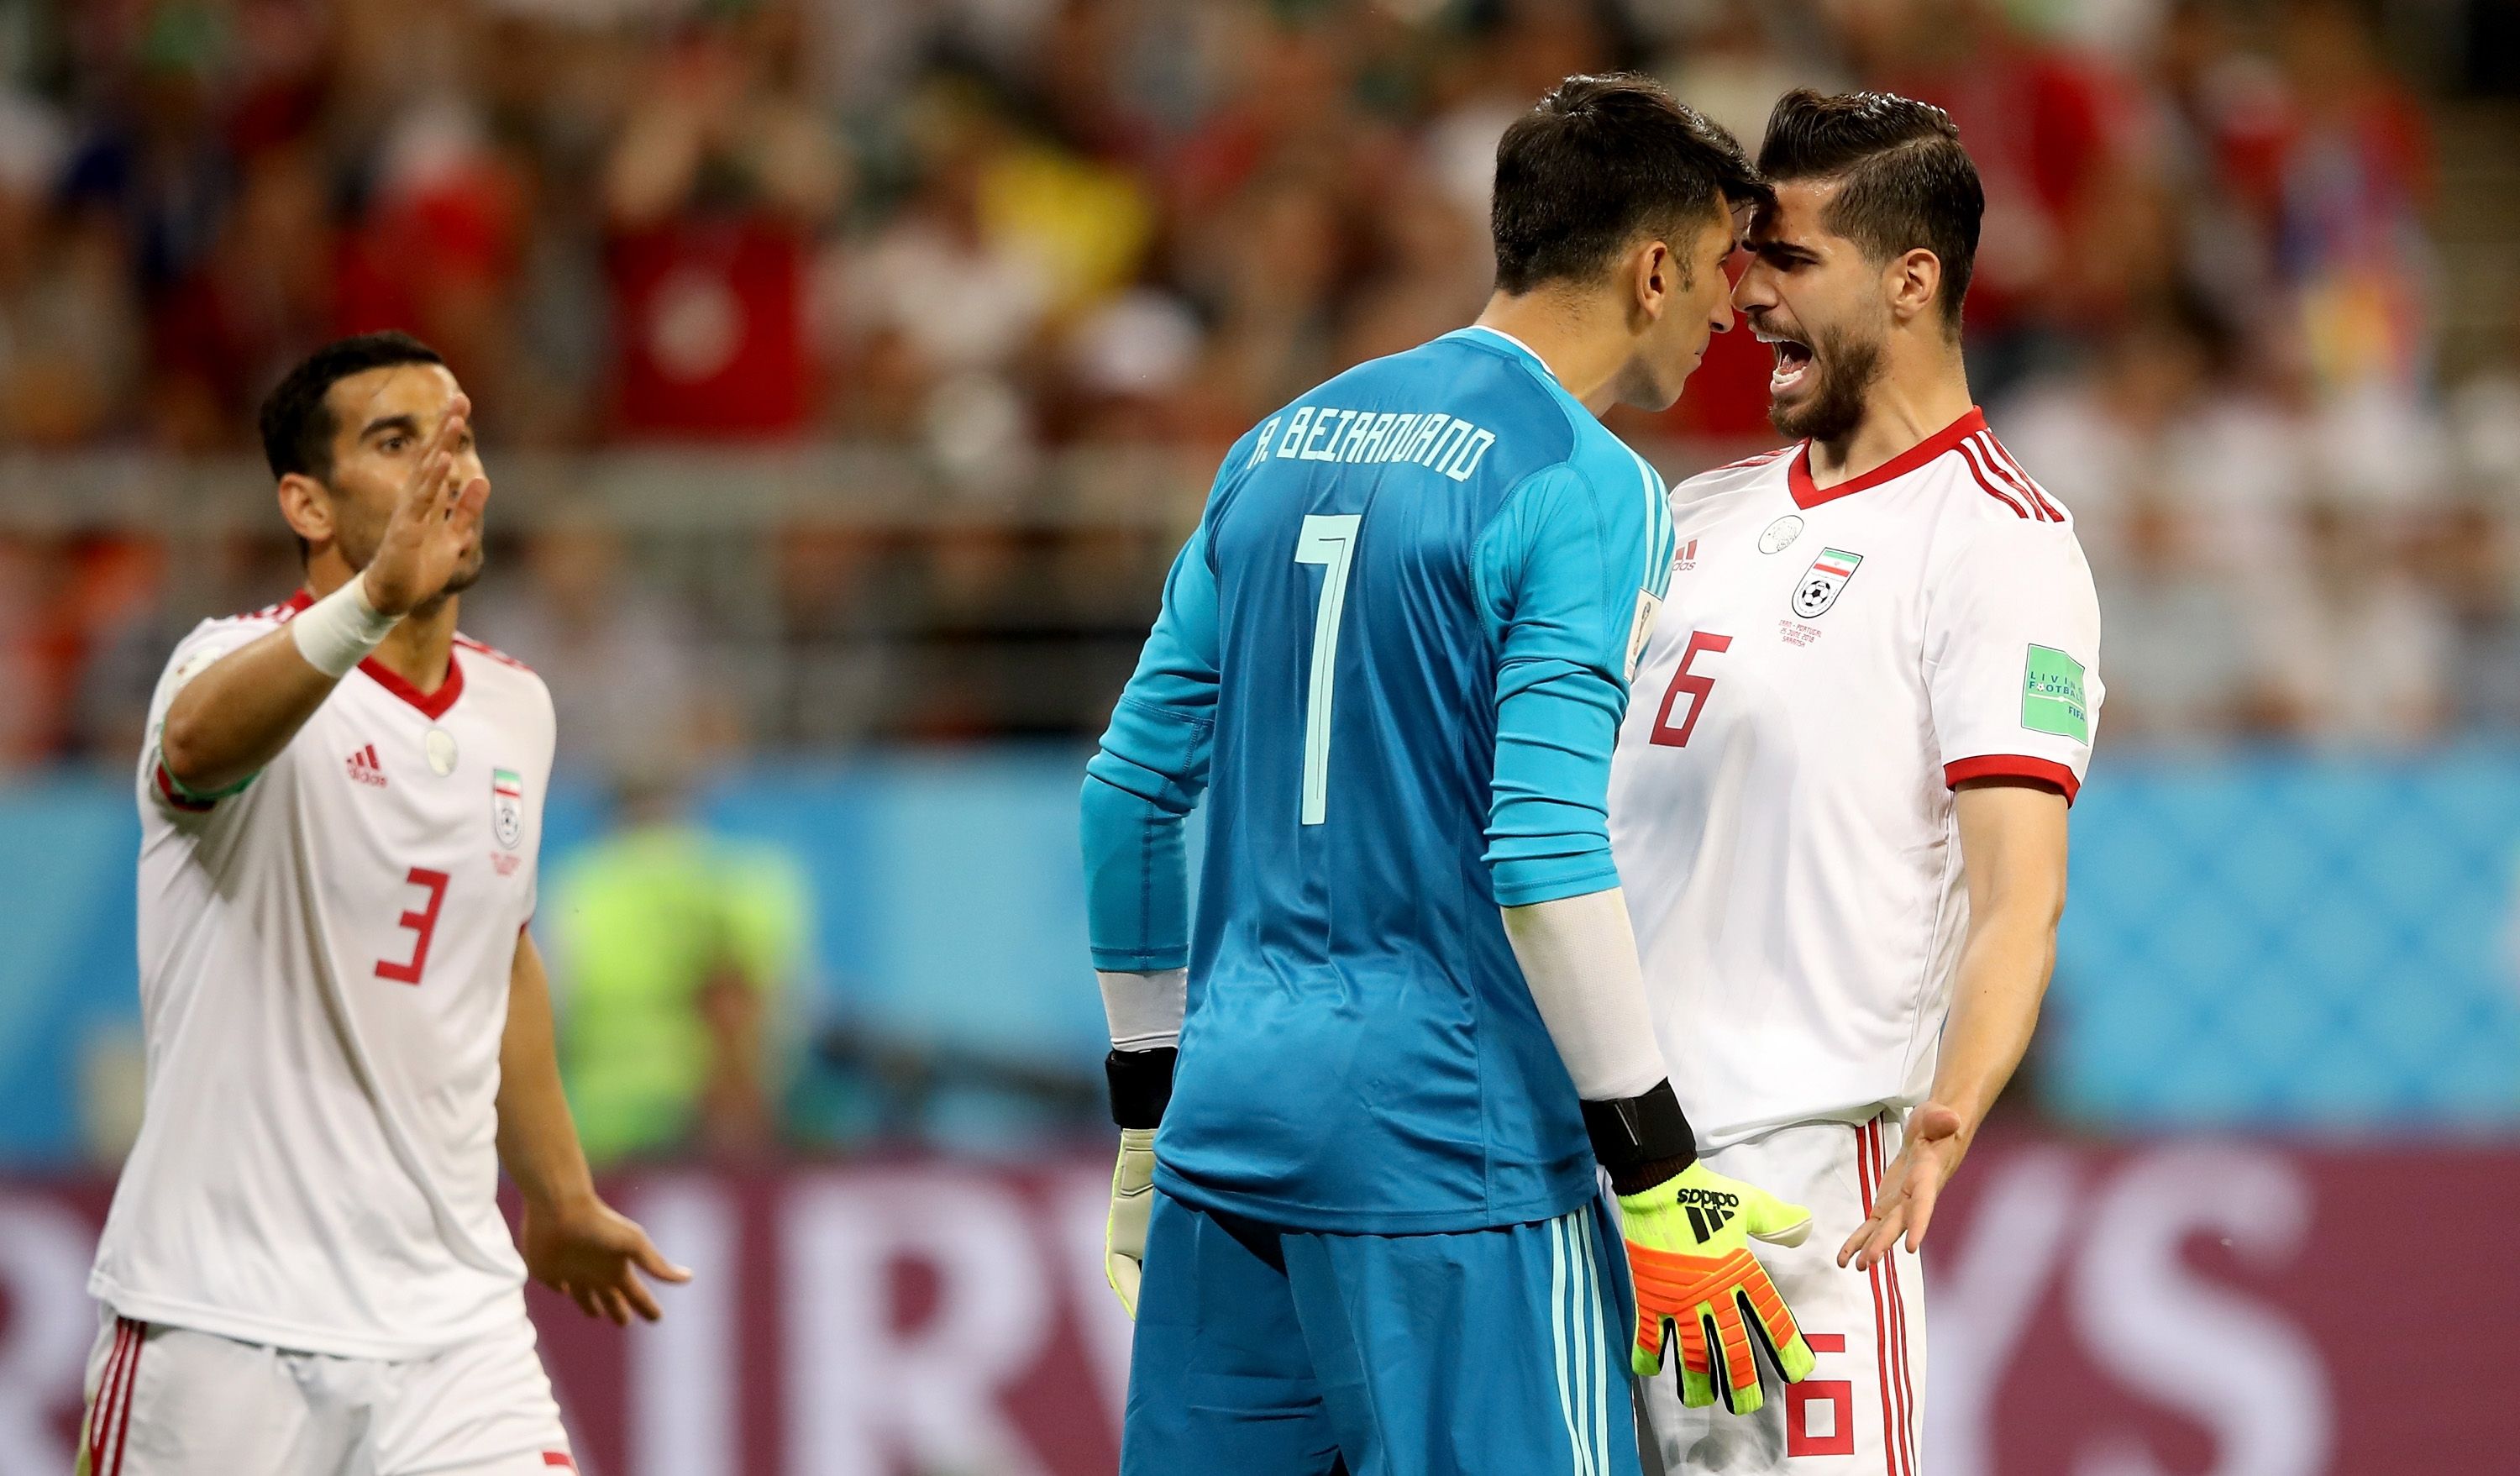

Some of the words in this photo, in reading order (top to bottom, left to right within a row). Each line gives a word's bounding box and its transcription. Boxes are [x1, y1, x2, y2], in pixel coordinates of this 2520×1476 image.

[1247, 415, 1281, 470] A.
[1276, 407, 1496, 482] BEIRANVAND
[1672, 559, 1696, 571] das
[1294, 514, 1362, 825] 1
[1801, 633, 1815, 643] 2018
[1649, 630, 1734, 749] 6
[2068, 706, 2085, 722] FIFA
[375, 867, 451, 986] 3
[1676, 1188, 1740, 1211] adidas
[1785, 1334, 1855, 1458] 6
